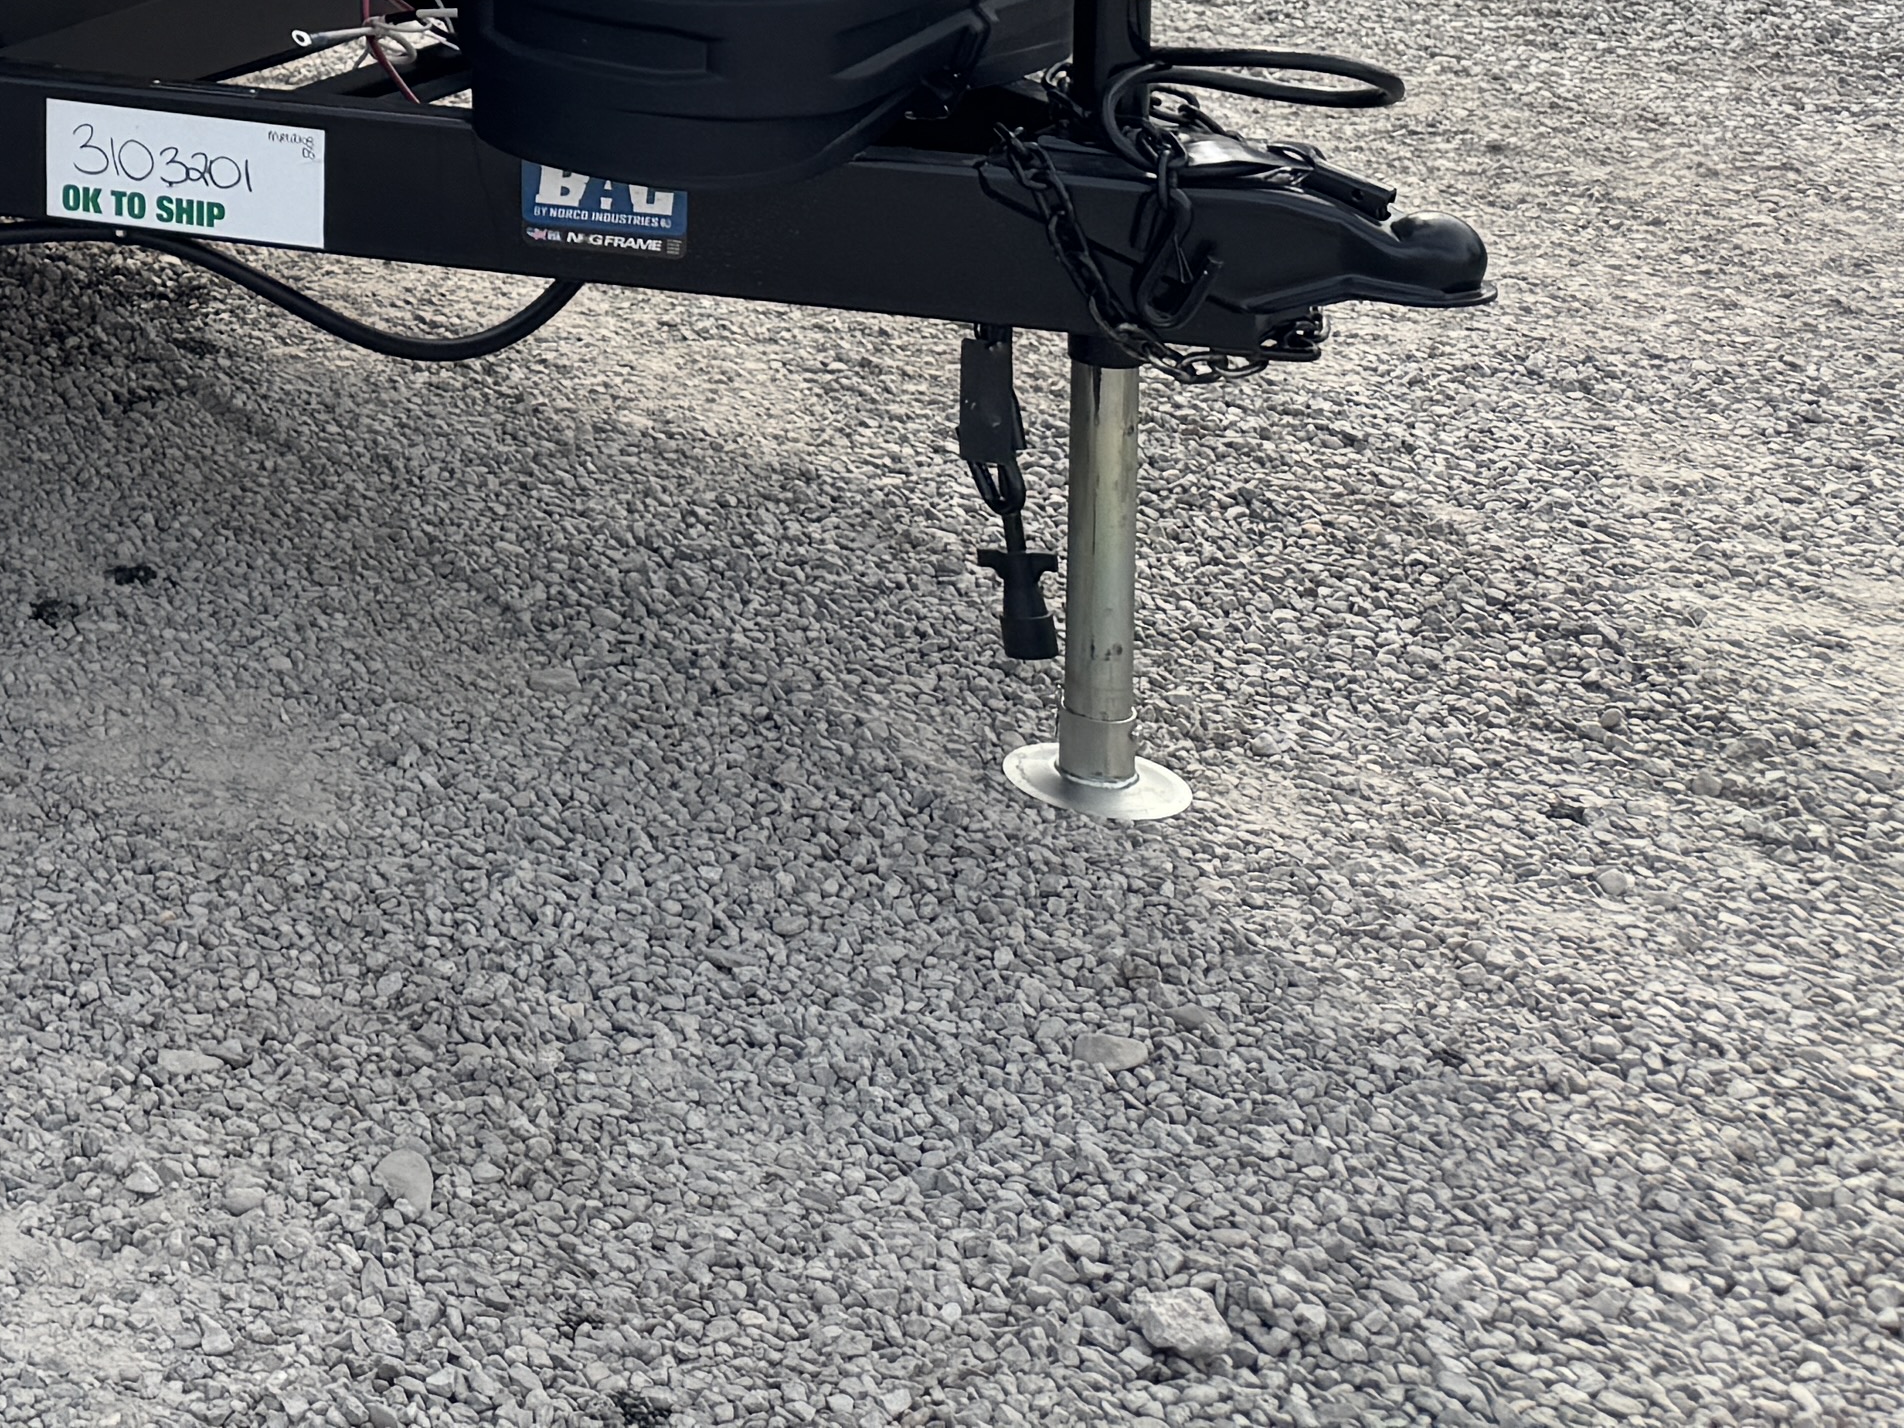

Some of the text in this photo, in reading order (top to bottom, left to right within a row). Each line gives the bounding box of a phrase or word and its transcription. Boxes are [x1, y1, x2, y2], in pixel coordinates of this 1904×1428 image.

[72, 123, 253, 193] 3103201
[62, 183, 226, 228] OK TO SHIP
[533, 205, 659, 227] BY NORCO INDUSTRIES
